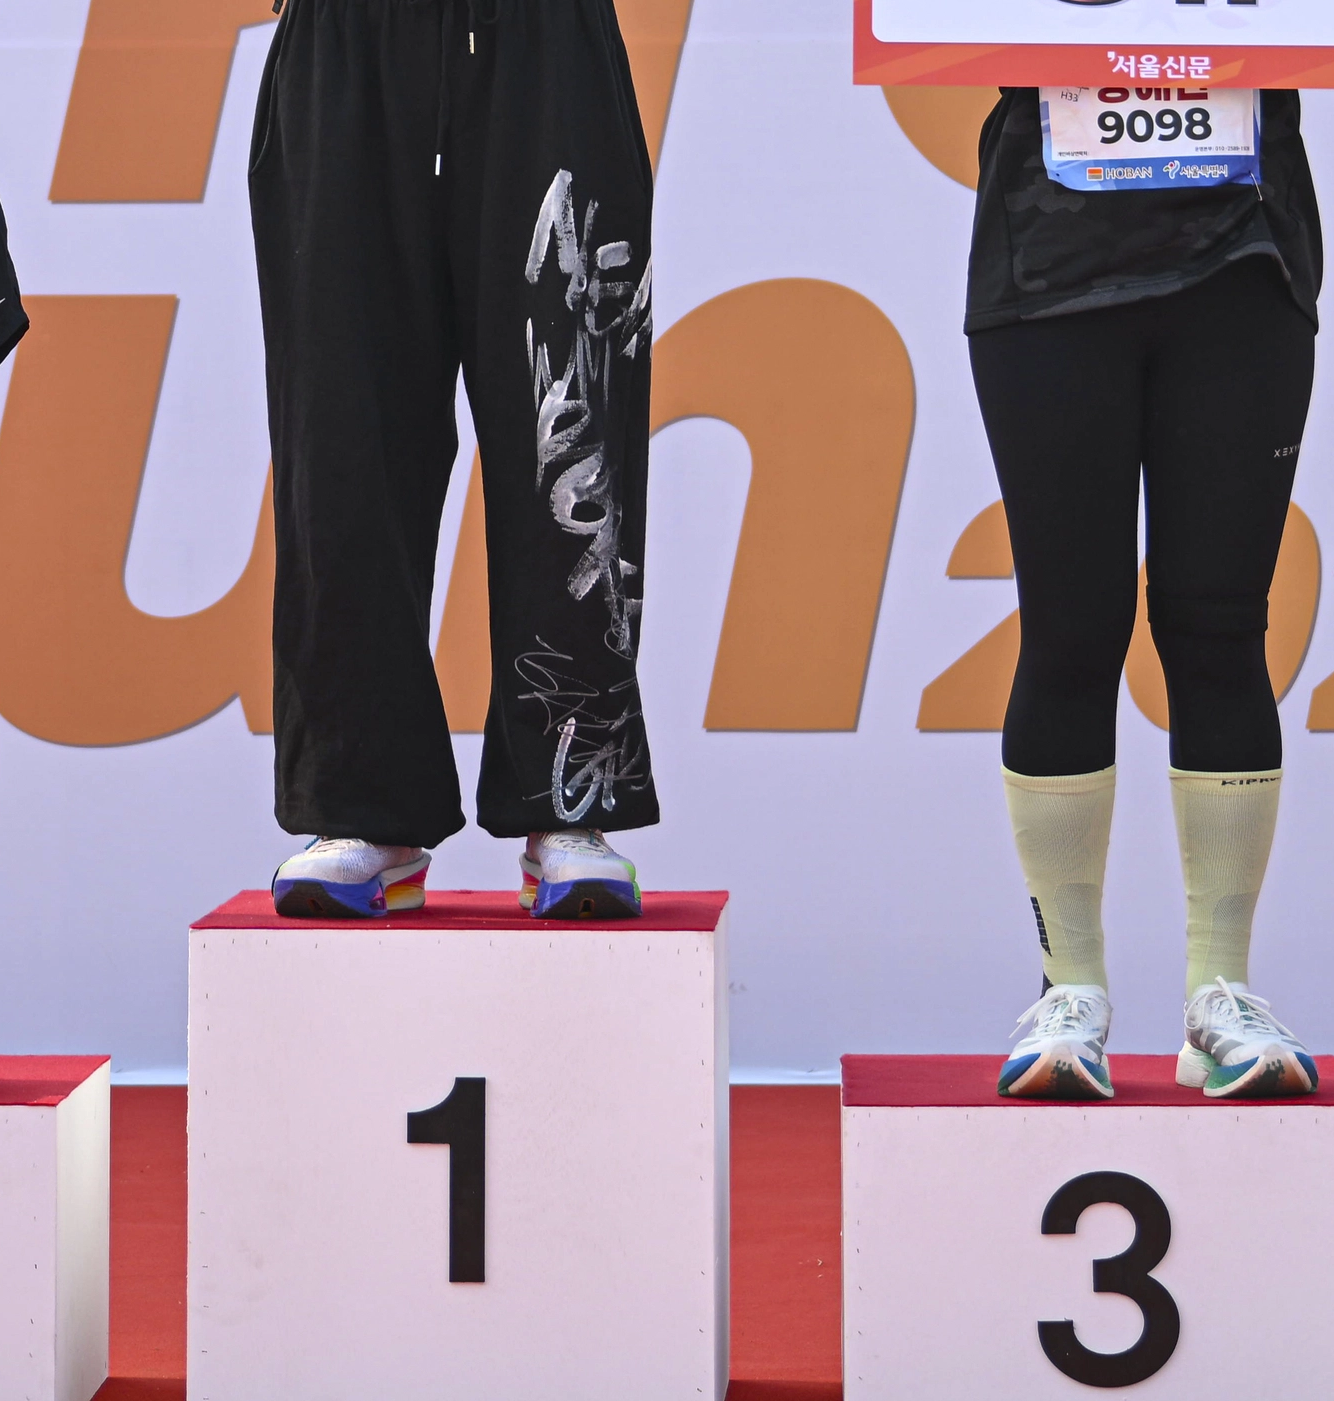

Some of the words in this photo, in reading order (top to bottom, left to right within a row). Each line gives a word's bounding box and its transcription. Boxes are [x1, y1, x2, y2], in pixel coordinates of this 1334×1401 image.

[1097, 108, 1212, 144] 9098
[1105, 166, 1152, 180] HOBAN
[1180, 164, 1228, 178] 서울특별시
[407, 1078, 485, 1283] 1
[1038, 1172, 1181, 1389] 3
